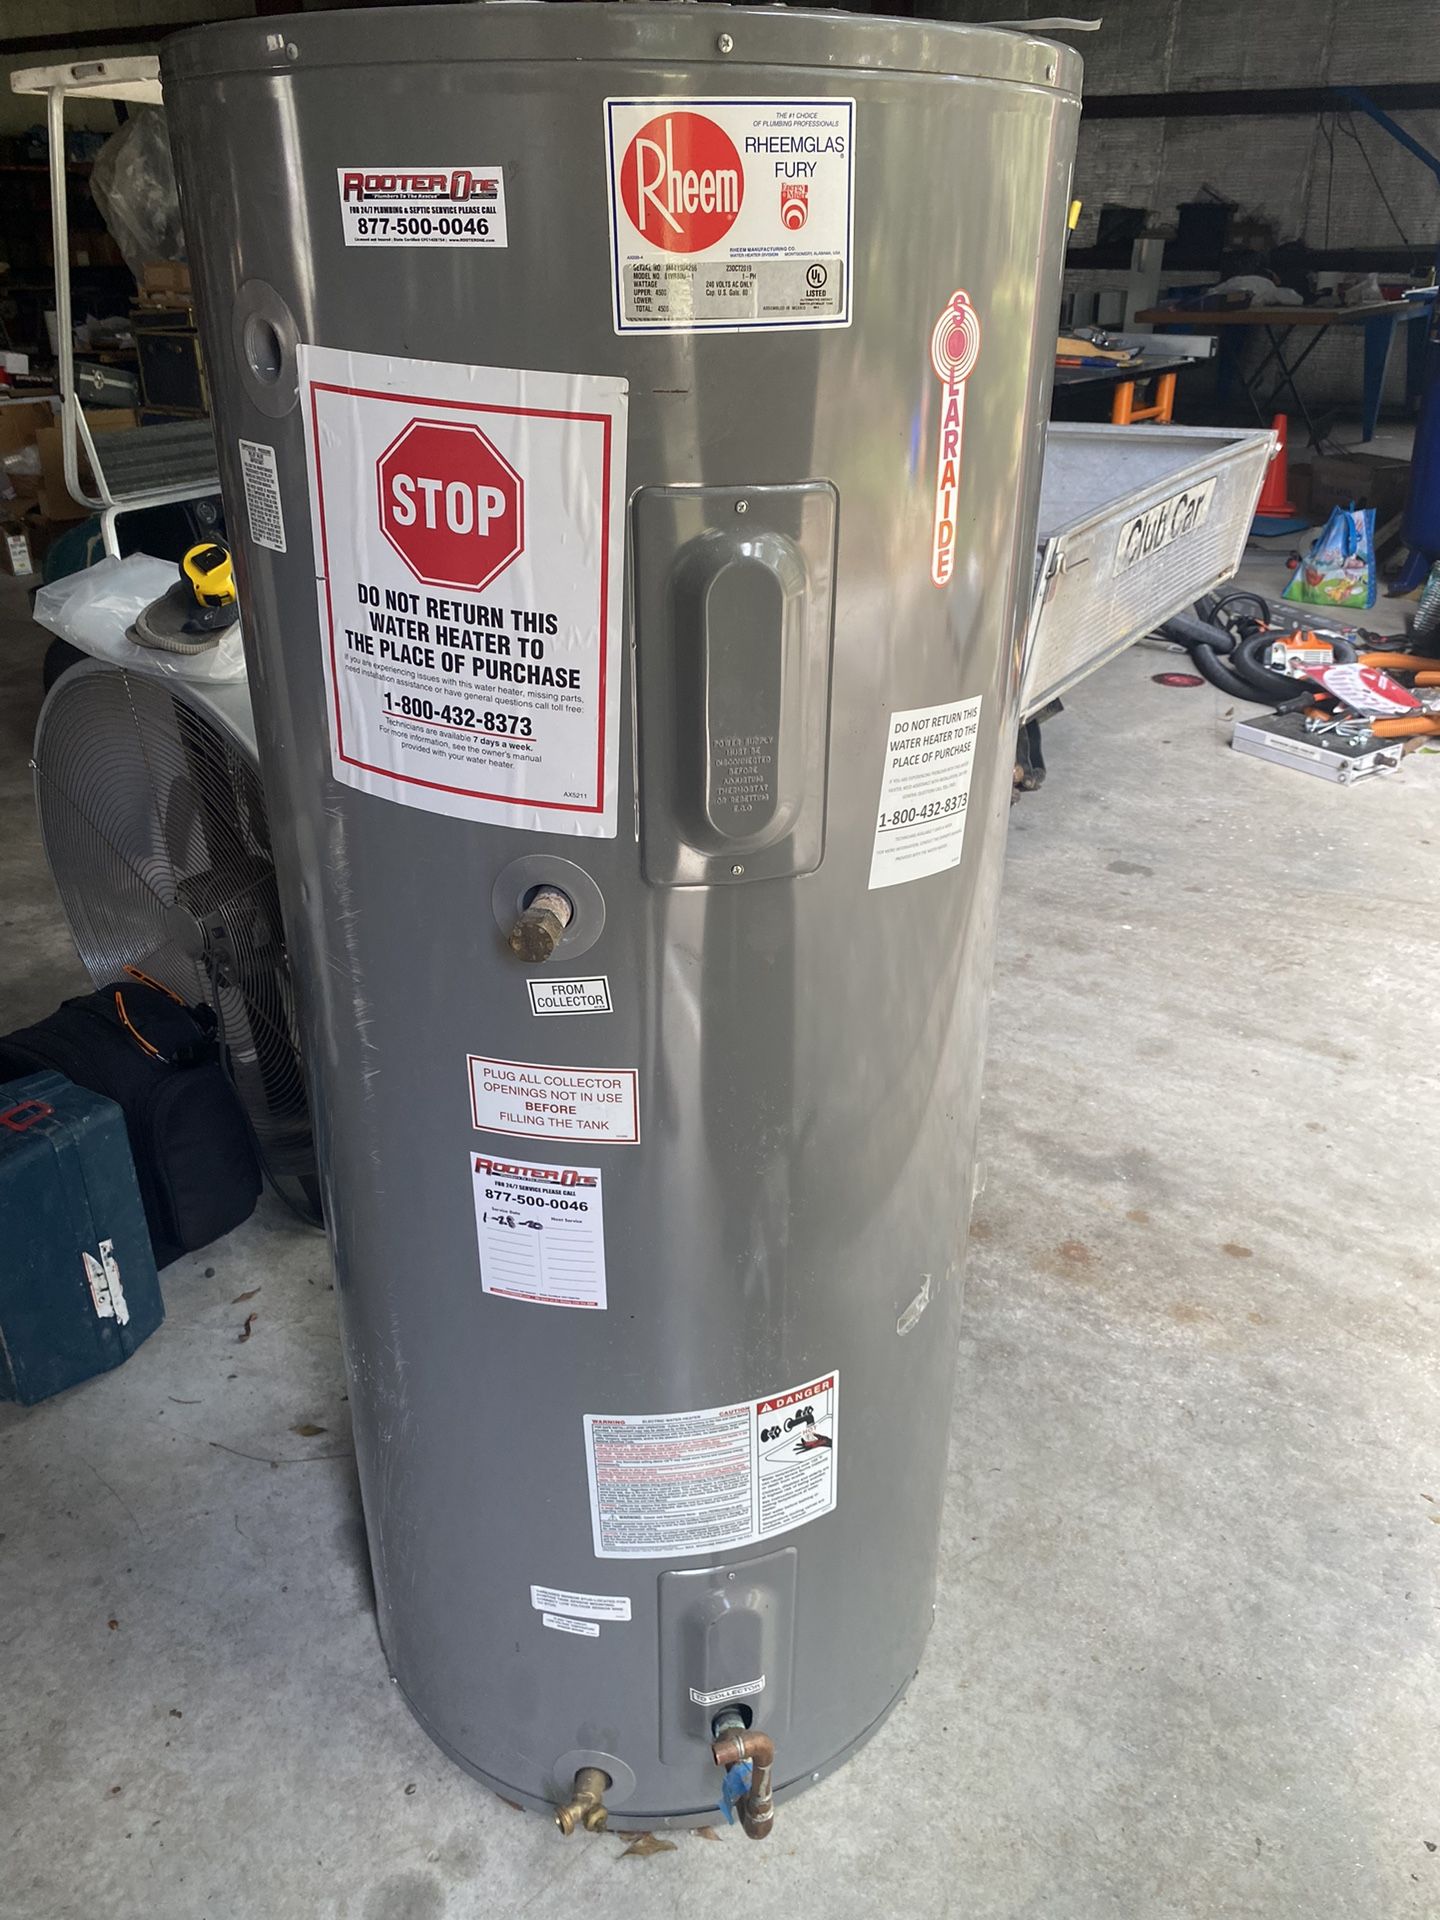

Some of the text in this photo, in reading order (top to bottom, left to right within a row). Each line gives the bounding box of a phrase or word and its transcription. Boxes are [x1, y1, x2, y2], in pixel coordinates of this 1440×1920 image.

[745, 136, 845, 153] RHEEMGLAS
[636, 118, 739, 234] Rheem
[775, 161, 817, 178] FURY
[343, 172, 448, 202] ROOTER
[409, 206, 431, 214] SEPTIC
[431, 206, 457, 214] SERVICE
[458, 206, 480, 214] PLEASE
[481, 206, 497, 214] CALL
[357, 217, 489, 235] 877-500-0046
[391, 472, 506, 537] STOP
[1126, 493, 1206, 565] Club Car
[357, 583, 558, 635] DO NOT RETURN THIS
[369, 611, 544, 660] WATER HEATER TO
[344, 629, 581, 690] THE PLACE OF PURCHASE
[345, 664, 361, 674] need
[361, 668, 395, 683] installation
[396, 678, 433, 692] assistance
[443, 687, 462, 697] have
[464, 692, 493, 702] general
[494, 696, 533, 708] questions
[534, 701, 550, 709] call
[551, 702, 564, 711] toll
[350, 656, 361, 664] you
[373, 661, 416, 680] experiencing
[416, 672, 440, 683] issues
[441, 676, 457, 686] with
[458, 679, 473, 689] this
[474, 683, 495, 692] water
[497, 685, 526, 698] heater,
[527, 689, 559, 701] missing
[560, 694, 584, 703] parts,
[383, 692, 532, 736] 1-800-432-8373
[894, 706, 978, 734] DO NOT RETURN THIS
[379, 725, 542, 763] For more information, see the owner's manual
[385, 716, 424, 733] Technicians
[426, 727, 438, 736] are
[439, 728, 472, 743] available
[473, 735, 479, 743] 7
[480, 737, 500, 748] days
[508, 742, 533, 752] week.
[890, 723, 977, 752] WATER HEATER TO THE
[401, 741, 515, 769] provided with your water heater.
[892, 741, 972, 768] PLACE OF PURCHASE
[563, 791, 588, 799] AX5211
[878, 792, 968, 828] 1-800-432-8373
[537, 995, 604, 1008] COLLECTOR
[551, 984, 585, 995] FROM
[483, 1067, 622, 1089] PLUG ALL COLLECTOR
[483, 1082, 623, 1103] OPENINGS NOT IN USE
[499, 1111, 609, 1130] FILLING THE TANK
[525, 1101, 577, 1115] BEFORE
[485, 1188, 589, 1212] 877-500-0046
[518, 1184, 542, 1193] SERVICE
[542, 1188, 562, 1196] PLEASE
[776, 1380, 830, 1408] DANGER
